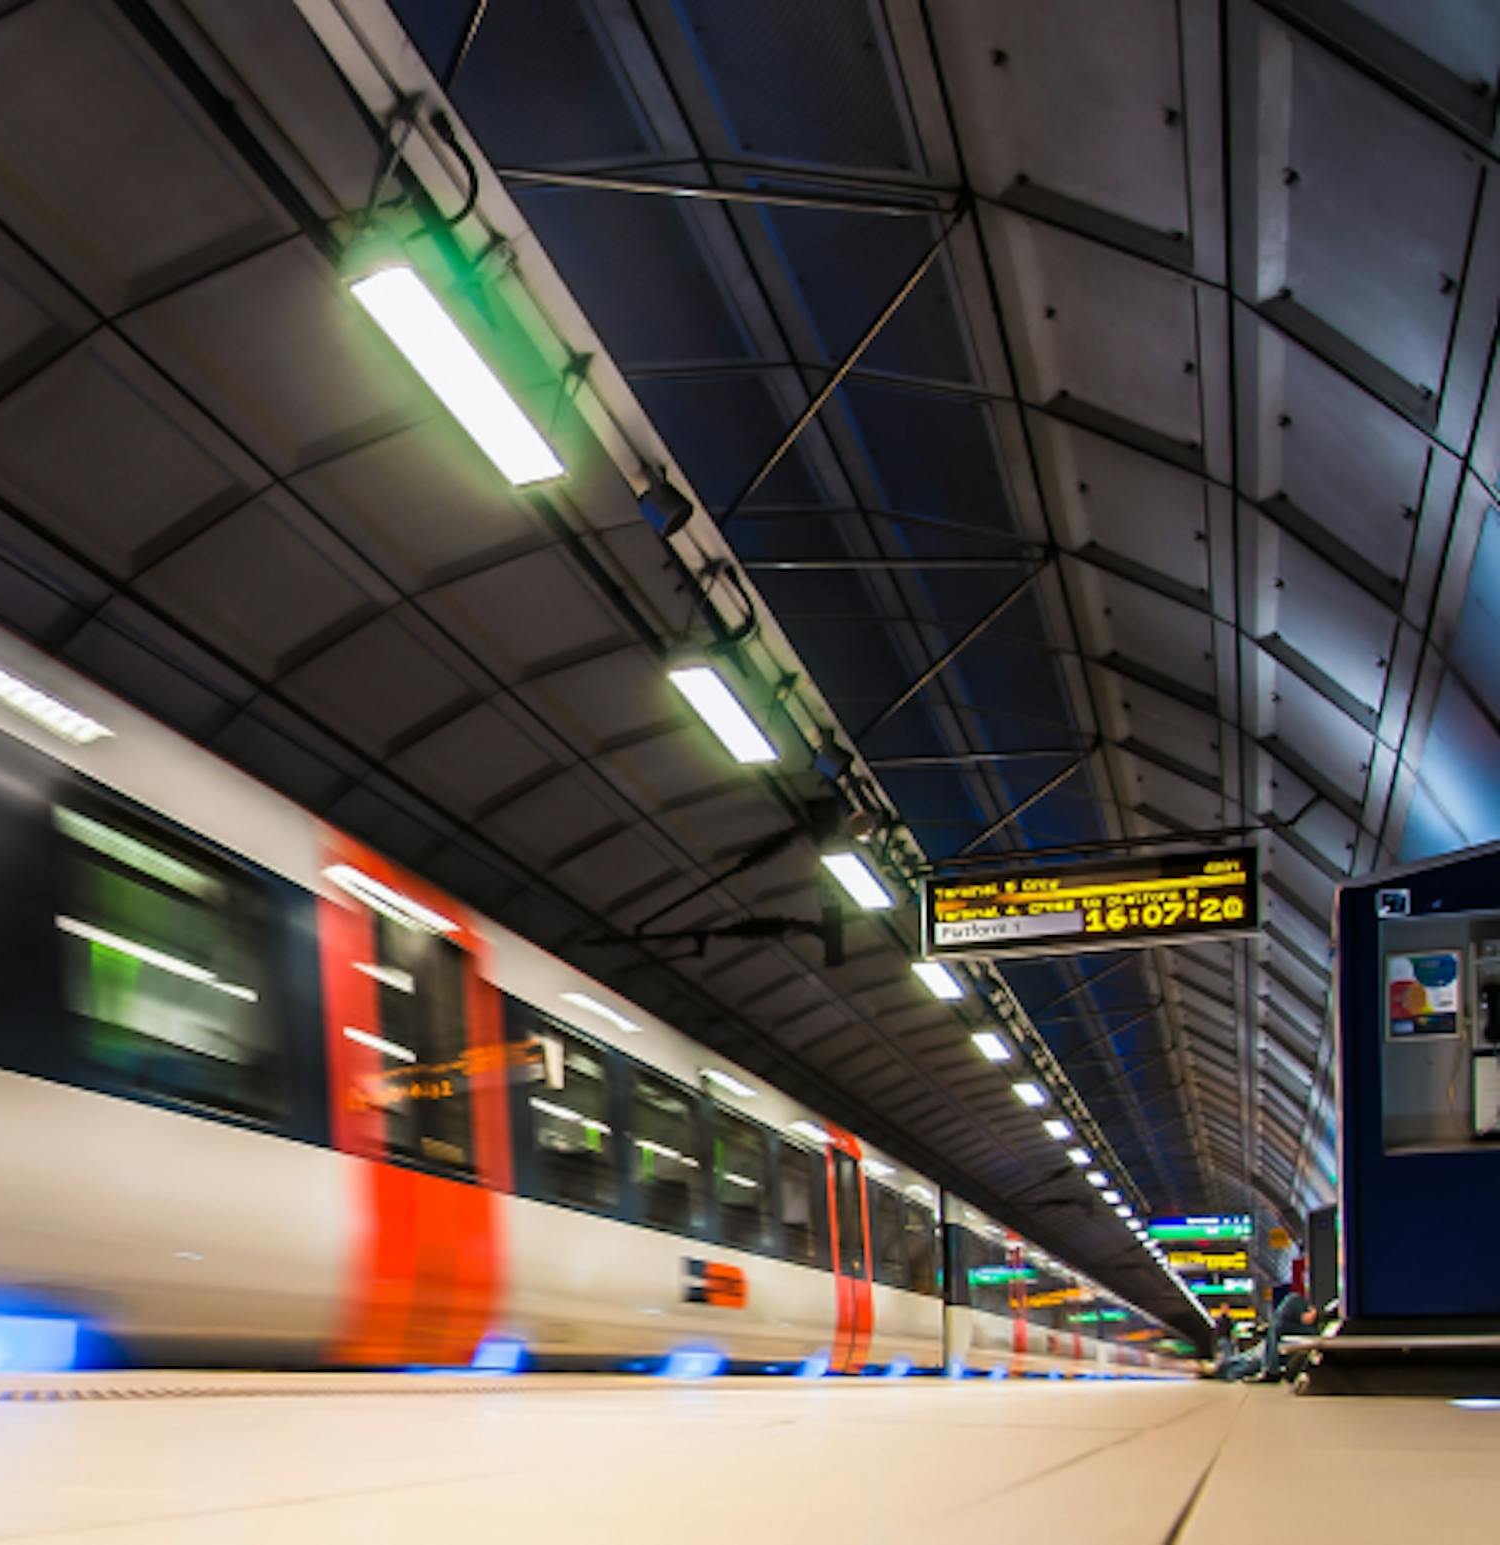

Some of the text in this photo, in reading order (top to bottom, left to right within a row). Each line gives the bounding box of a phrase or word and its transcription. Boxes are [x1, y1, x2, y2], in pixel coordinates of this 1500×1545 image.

[934, 882, 998, 900] Terminal
[1085, 895, 1244, 933] 16:07:20
[942, 922, 1007, 938] Platform
